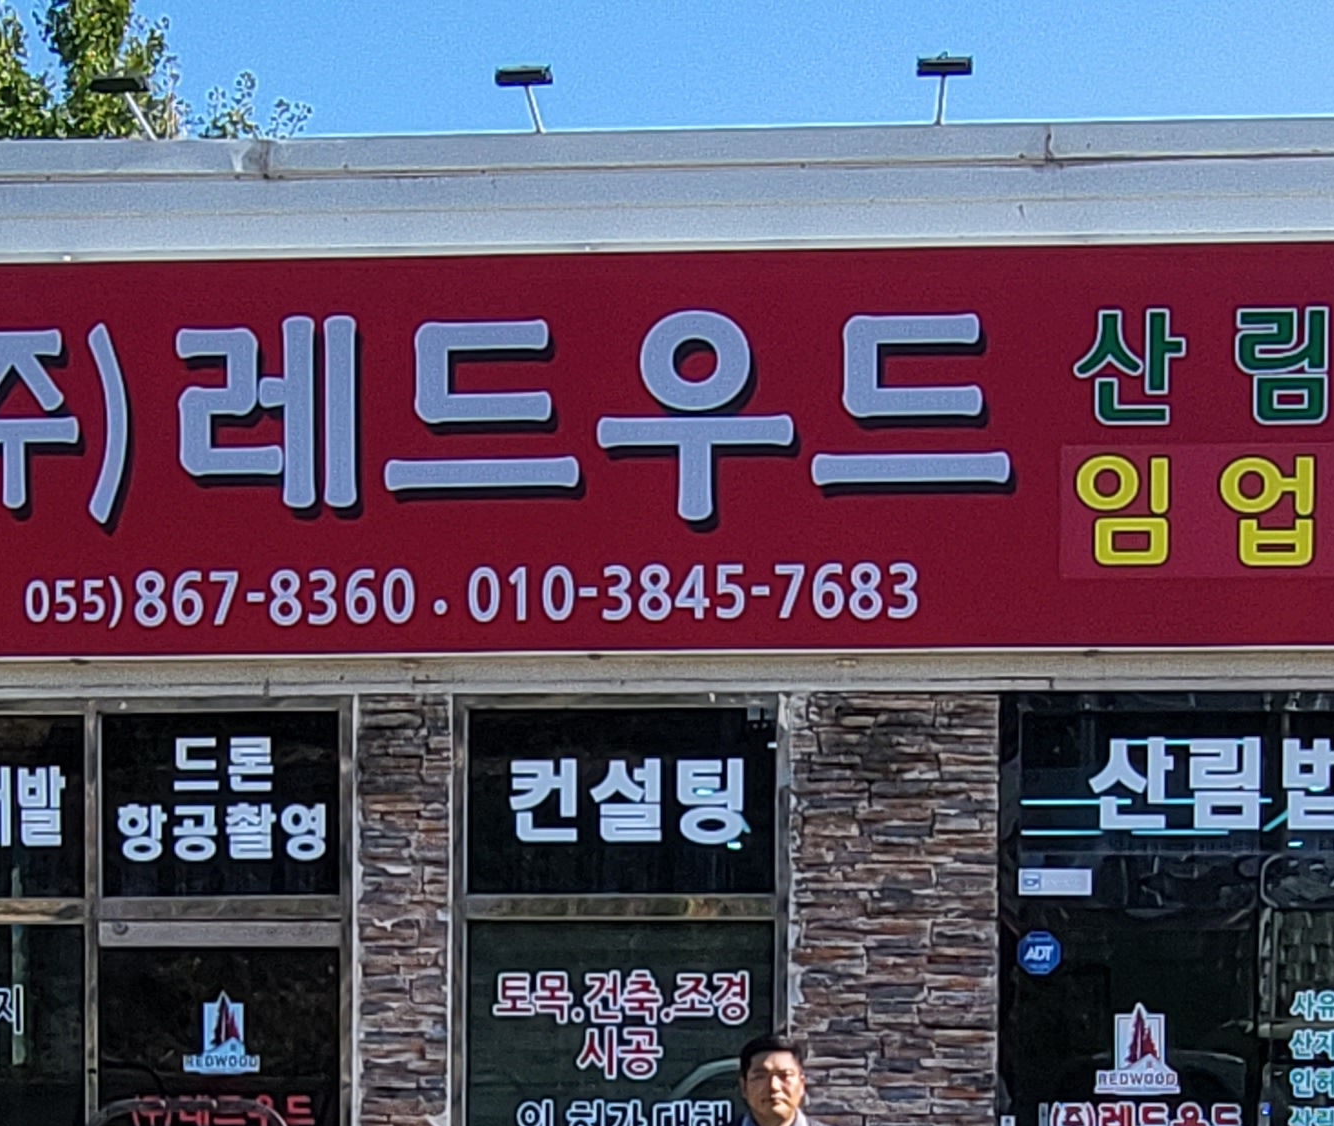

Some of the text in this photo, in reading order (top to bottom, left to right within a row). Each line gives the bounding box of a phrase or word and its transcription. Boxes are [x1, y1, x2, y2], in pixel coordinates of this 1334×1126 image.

[25, 562, 919, 629] 055)867-8360 010-3845-7683
[173, 736, 274, 793] 드론
[509, 757, 747, 845] 컨설팅
[117, 803, 327, 862] 항공촬영
[1023, 943, 1054, 962] ADT
[185, 1054, 259, 1068] REDWOOD
[576, 1027, 664, 1081] 시공
[1097, 1072, 1177, 1086] REDWOOD
